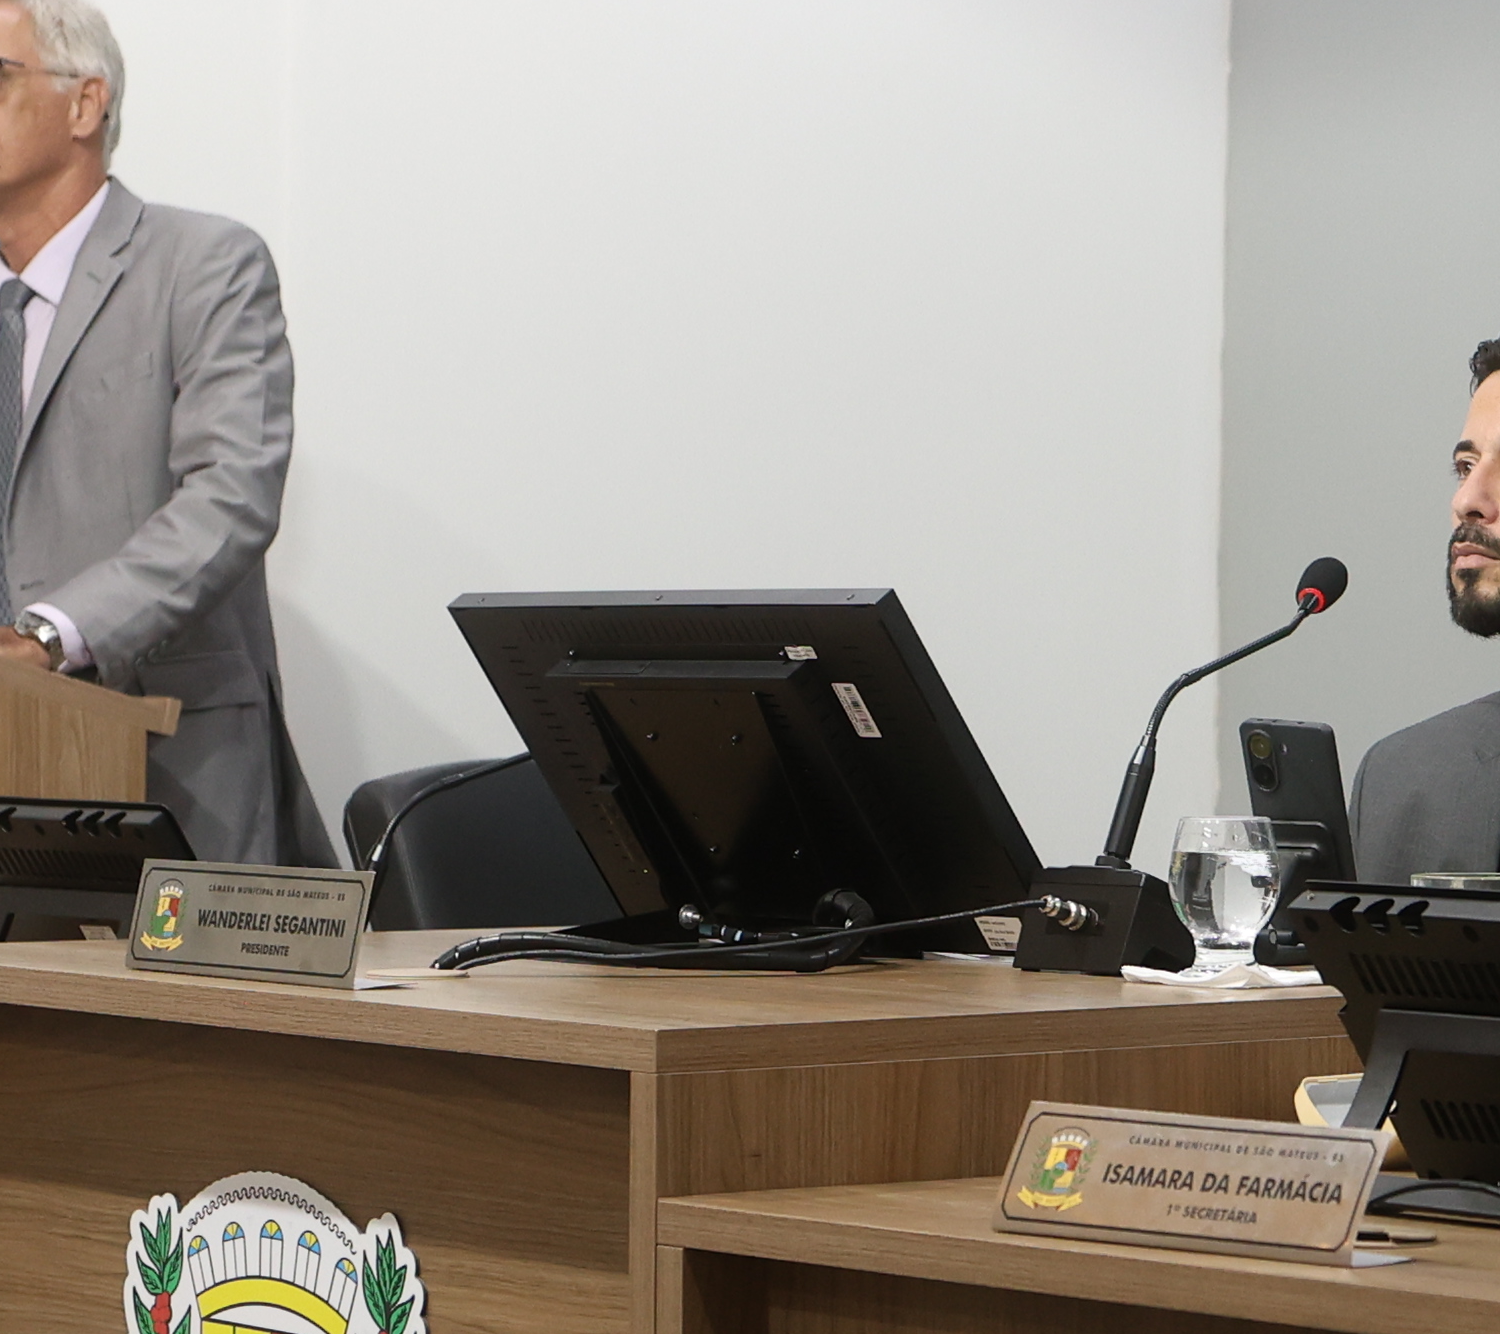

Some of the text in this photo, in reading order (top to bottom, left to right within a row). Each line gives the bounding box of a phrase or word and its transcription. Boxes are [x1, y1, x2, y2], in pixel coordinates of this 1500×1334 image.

[198, 909, 346, 938] WANDERLEI SEGANTINI
[241, 942, 290, 956] PRESIDENTE
[1175, 1140, 1231, 1154] MUNICIPAL
[1102, 1163, 1343, 1205] ISAMARA DA FARMÁCIA
[1182, 1205, 1258, 1224] SECRETÁRIA
